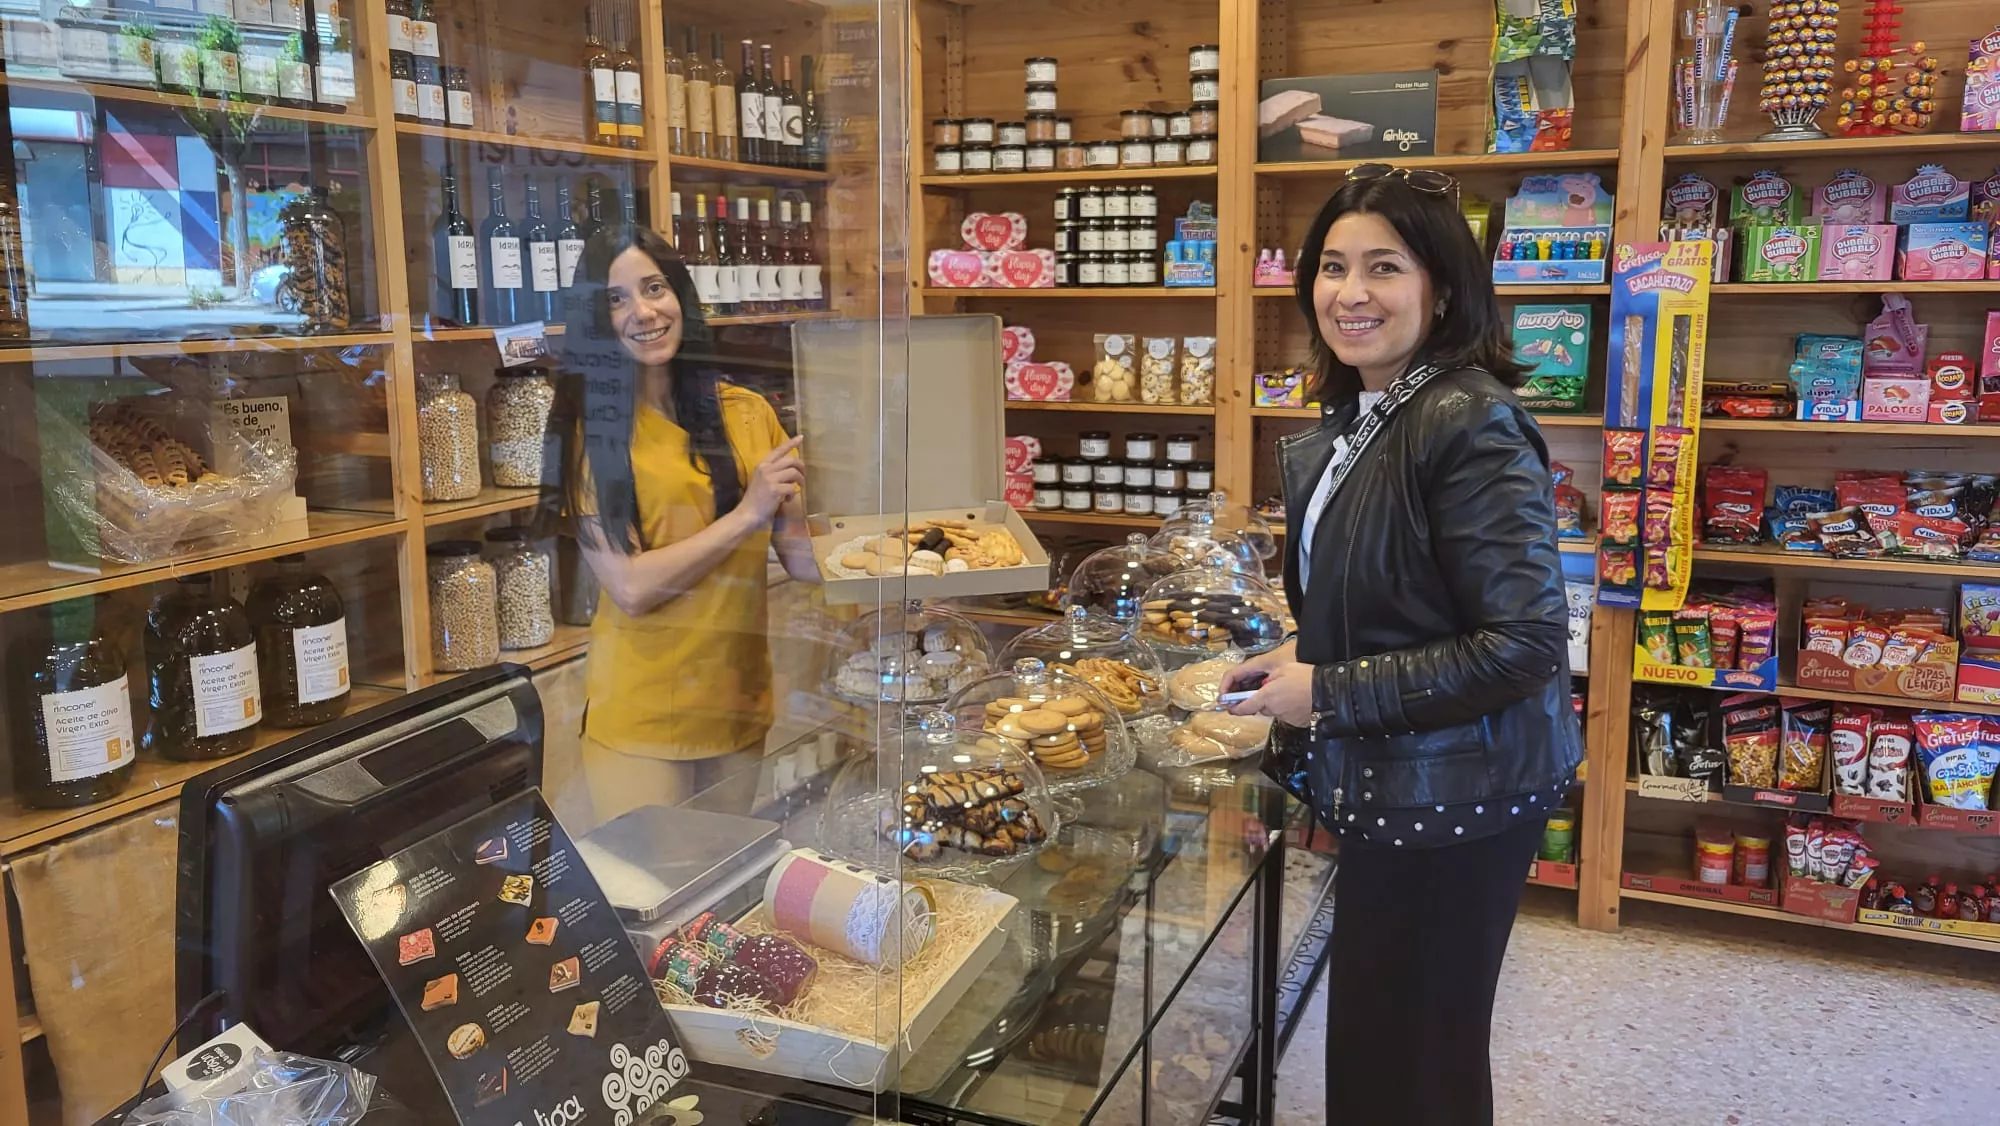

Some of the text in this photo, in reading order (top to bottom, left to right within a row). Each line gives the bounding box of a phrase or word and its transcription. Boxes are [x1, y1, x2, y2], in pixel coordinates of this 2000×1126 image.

[1695, 37, 1703, 77] mentos
[1746, 182, 1785, 193] DUBBLE
[1827, 180, 1869, 194] DUBBLE
[1908, 176, 1951, 191] DUBBLE
[1671, 184, 1709, 196] DUBBLE
[1748, 189, 1787, 201] BUBBLE
[1829, 188, 1871, 201] BUBBLE
[1909, 184, 1953, 198] BUBBLE
[1673, 192, 1711, 203] BUBBLE
[1766, 238, 1802, 251] DUBBLE
[1836, 237, 1875, 249] DUBBLE
[1930, 244, 1964, 254] DUBBLE
[1678, 243, 1701, 257] 1+1
[1767, 245, 1804, 258] BUBBLE
[1838, 244, 1876, 256] BUBBLE
[1932, 250, 1966, 261] BUBBLE
[1618, 250, 1660, 273] Grefusa
[1667, 256, 1708, 267] GRATIS
[1629, 274, 1694, 293] CACAHUETAZO
[242, 400, 283, 414] bueno,
[1816, 405, 1843, 414] VIDAL
[1868, 405, 1922, 414] PALOTES
[243, 414, 258, 425] de
[1860, 505, 1893, 513] VIDAL
[1919, 506, 1952, 516] VIDAL
[1823, 521, 1853, 532] VIDAL
[1808, 626, 1844, 636] Grefusa
[1854, 627, 1885, 641] Grefusa
[1642, 666, 1698, 681] NUEVO
[1800, 666, 1850, 679] Grefusa
[1915, 667, 1945, 680] PIPAS
[200, 676, 226, 685] Aceite
[227, 673, 238, 681] de
[1907, 677, 1951, 692] LENTEJA
[201, 684, 228, 693] Virgen
[55, 706, 119, 726] Aceite de Oliva
[55, 719, 110, 734] Virgen Extra
[1927, 729, 1979, 748] Grefusa
[1879, 806, 1905, 814] PIPAS
[1967, 815, 1994, 823] PIPAS
[1679, 883, 1723, 895] ORIGINAL
